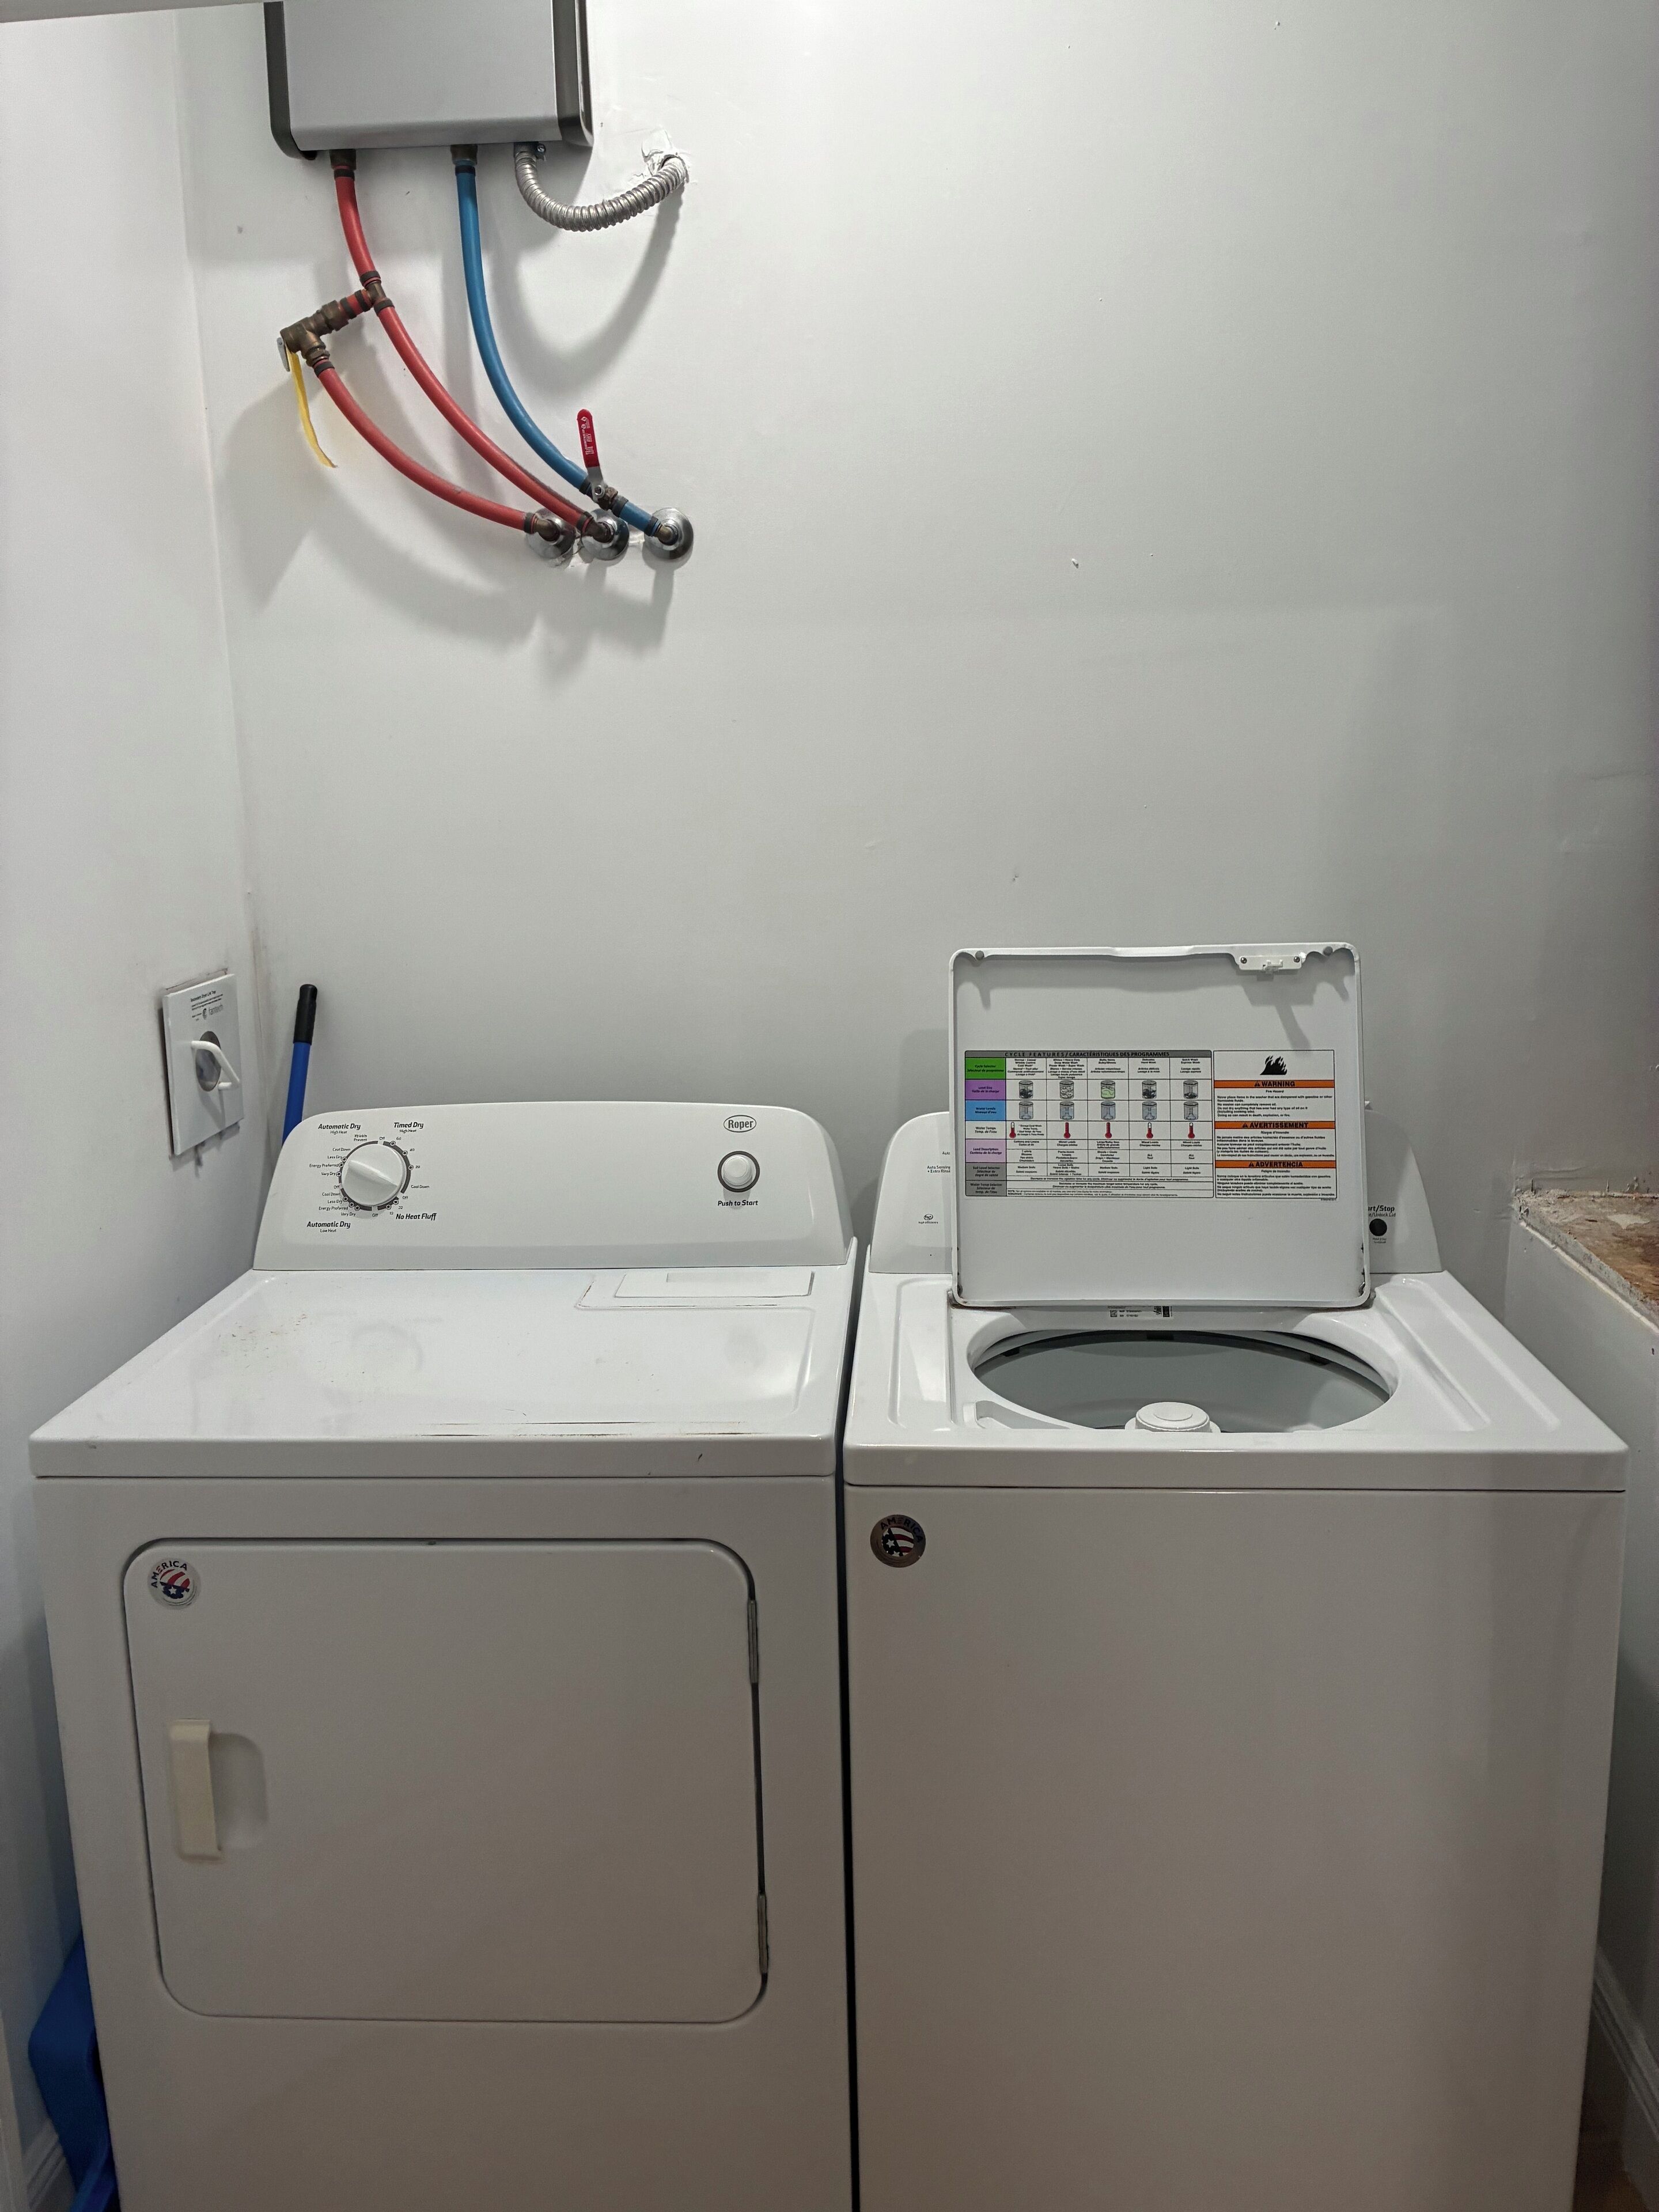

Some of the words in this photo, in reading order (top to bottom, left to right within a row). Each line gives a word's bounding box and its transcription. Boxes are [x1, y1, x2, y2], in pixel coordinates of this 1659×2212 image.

[728, 1119, 753, 1130] Roper
[880, 1516, 923, 1543] AMERICA
[151, 1560, 187, 1588] AMERICA
